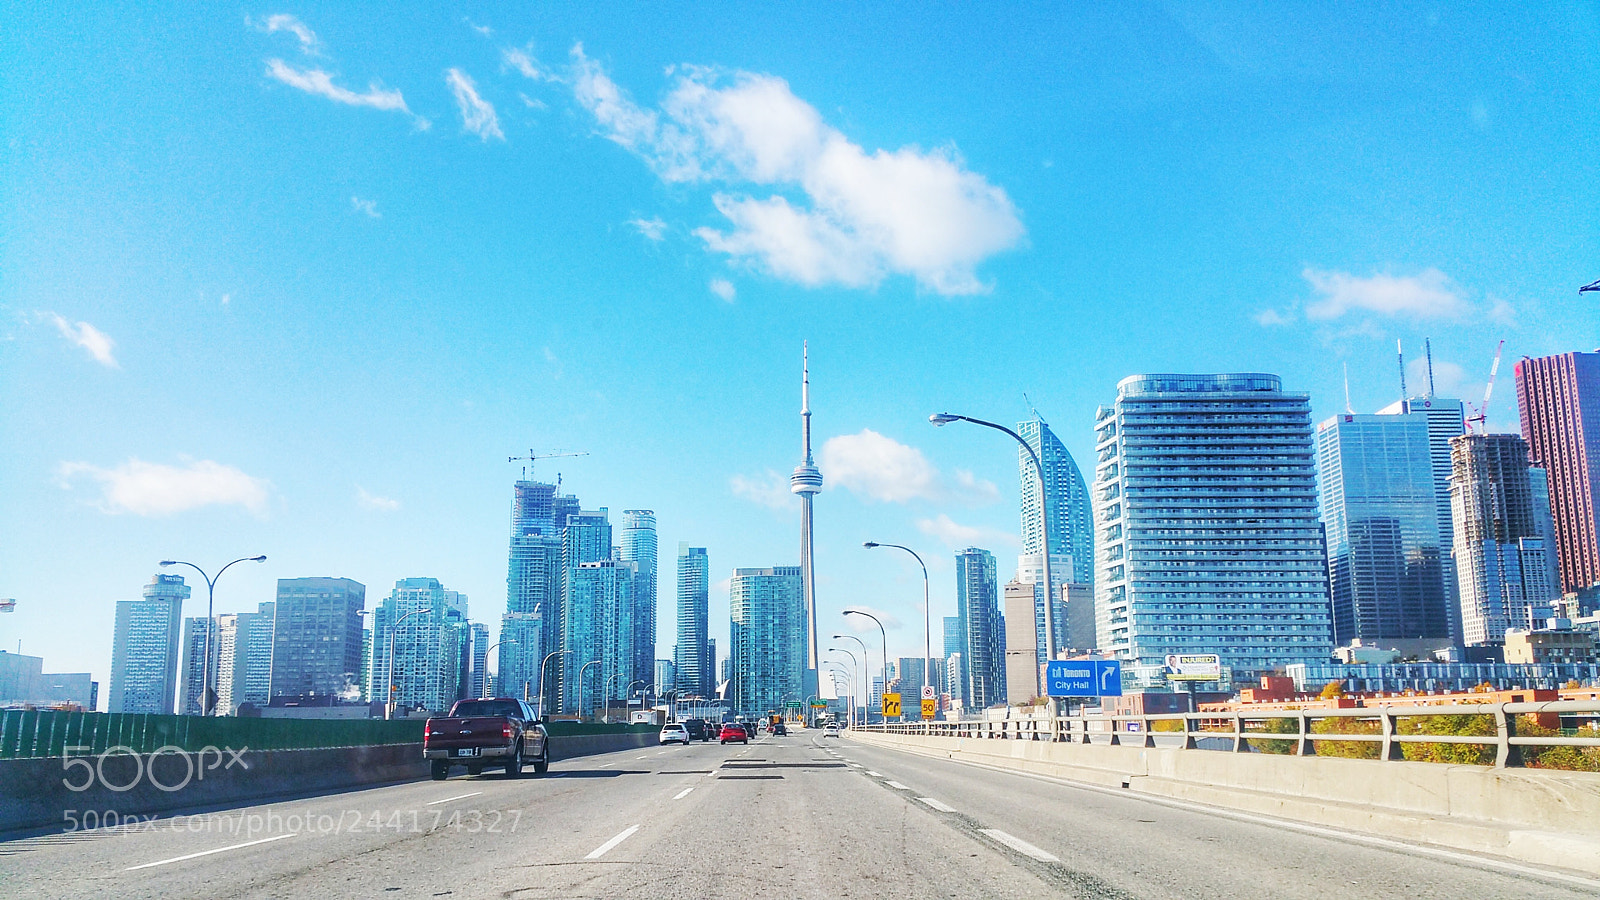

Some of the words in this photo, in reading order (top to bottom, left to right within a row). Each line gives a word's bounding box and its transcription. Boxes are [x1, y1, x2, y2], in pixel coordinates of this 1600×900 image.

[1055, 681, 1071, 690] City
[1073, 681, 1089, 689] Hall
[923, 704, 934, 712] 50
